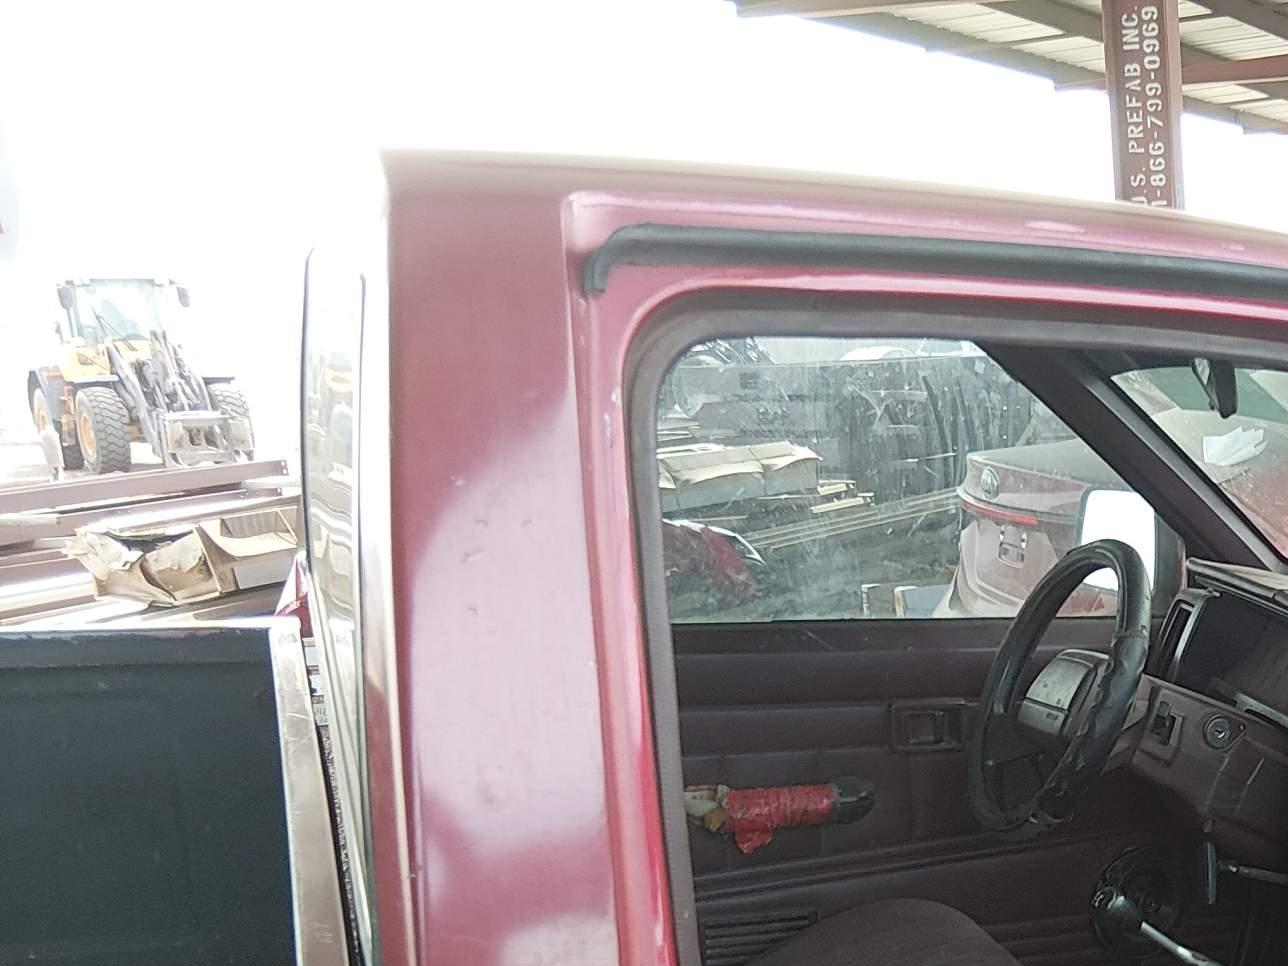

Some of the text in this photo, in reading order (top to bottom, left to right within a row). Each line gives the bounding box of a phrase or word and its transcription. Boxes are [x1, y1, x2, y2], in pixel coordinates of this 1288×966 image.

[1121, 6, 1140, 51] INC.
[1124, 62, 1145, 153] PREFAB
[1141, 5, 1168, 209] 1-866-799-0969
